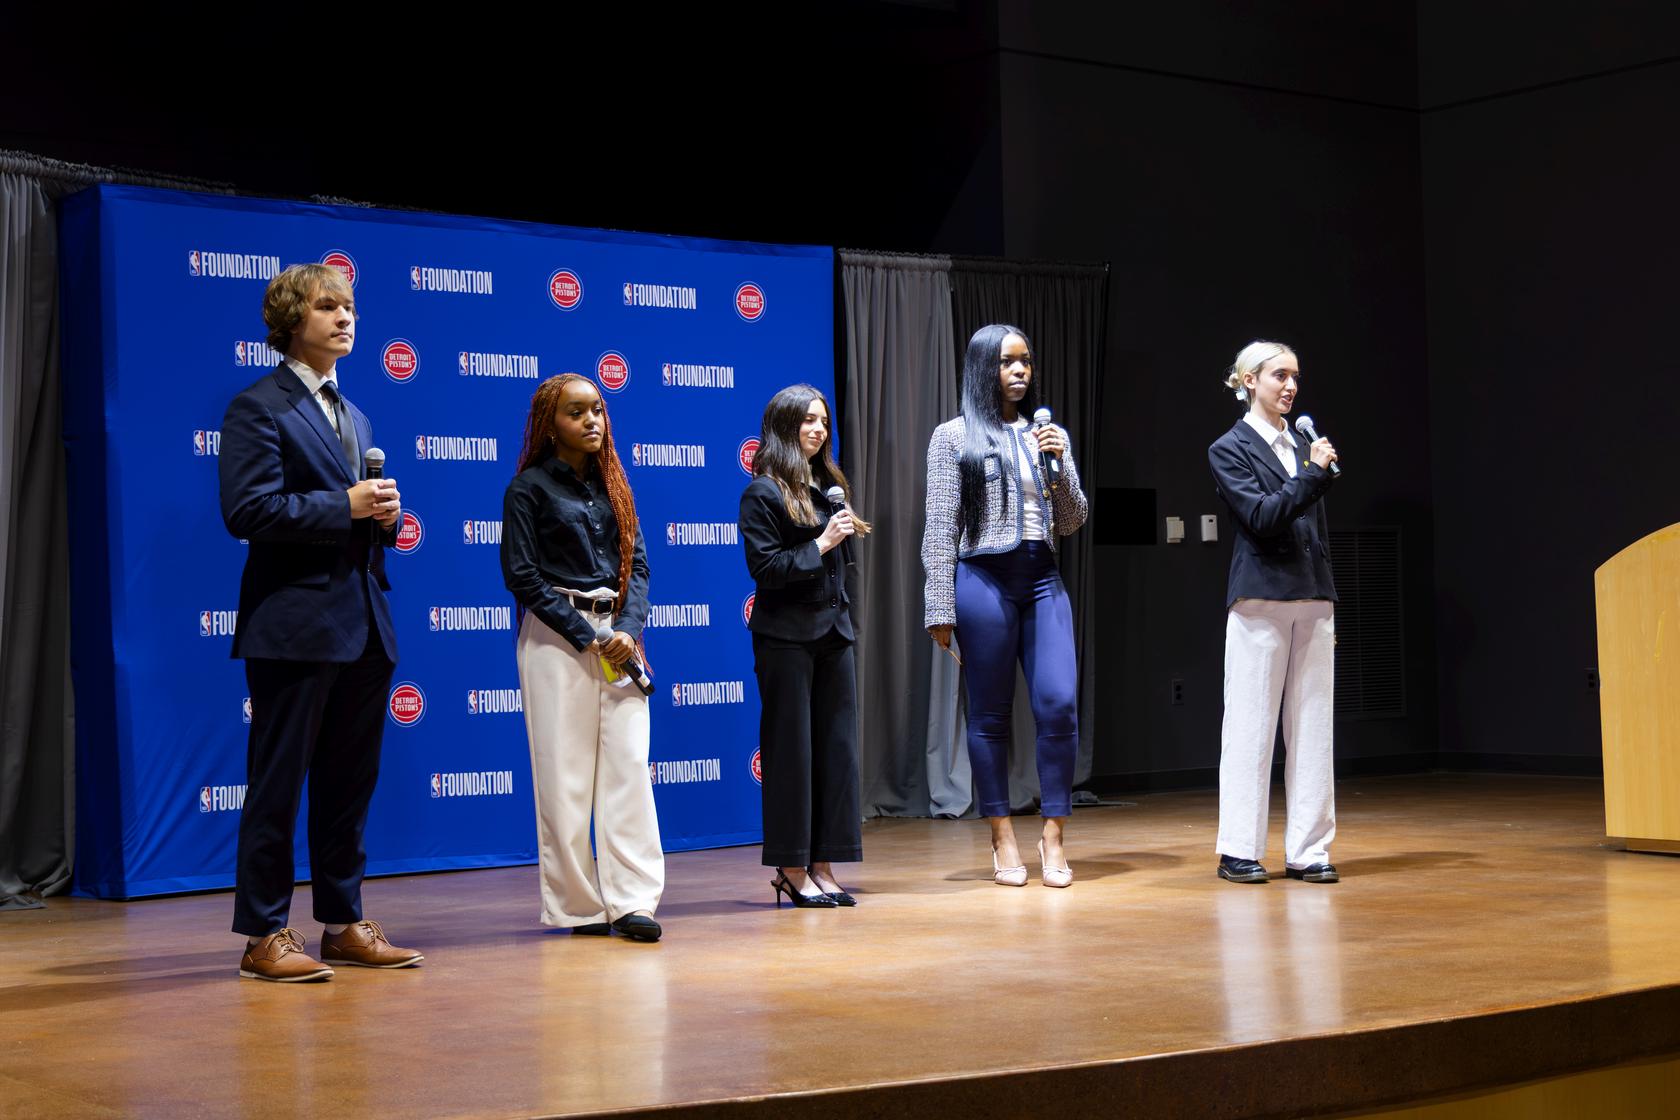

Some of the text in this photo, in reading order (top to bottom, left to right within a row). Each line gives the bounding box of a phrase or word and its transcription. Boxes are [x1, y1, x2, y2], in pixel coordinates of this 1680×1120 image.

[201, 252, 281, 281] FOUNDATION
[421, 267, 493, 295] FOUNDATION
[555, 281, 577, 289] DETROIT
[555, 288, 577, 297] PISTONS
[633, 283, 697, 309] FOUNDATION
[388, 360, 412, 368] PISTONS
[469, 352, 539, 378] FOUNDATION
[603, 371, 624, 379] PISTONS
[672, 363, 734, 388] FOUNDATION
[426, 436, 498, 461] FOUNDATION
[642, 443, 705, 467] FOUNDATION
[676, 523, 738, 545] FOUNDATION
[440, 606, 511, 630] FOUNDATION
[647, 604, 710, 627] FOUNDATION
[479, 689, 523, 713] FOUNDA
[681, 681, 744, 705] FOUNDATION
[395, 704, 419, 712] PISTONS
[657, 759, 721, 784] FOUNDATION
[442, 771, 513, 797] FOUNDATION
